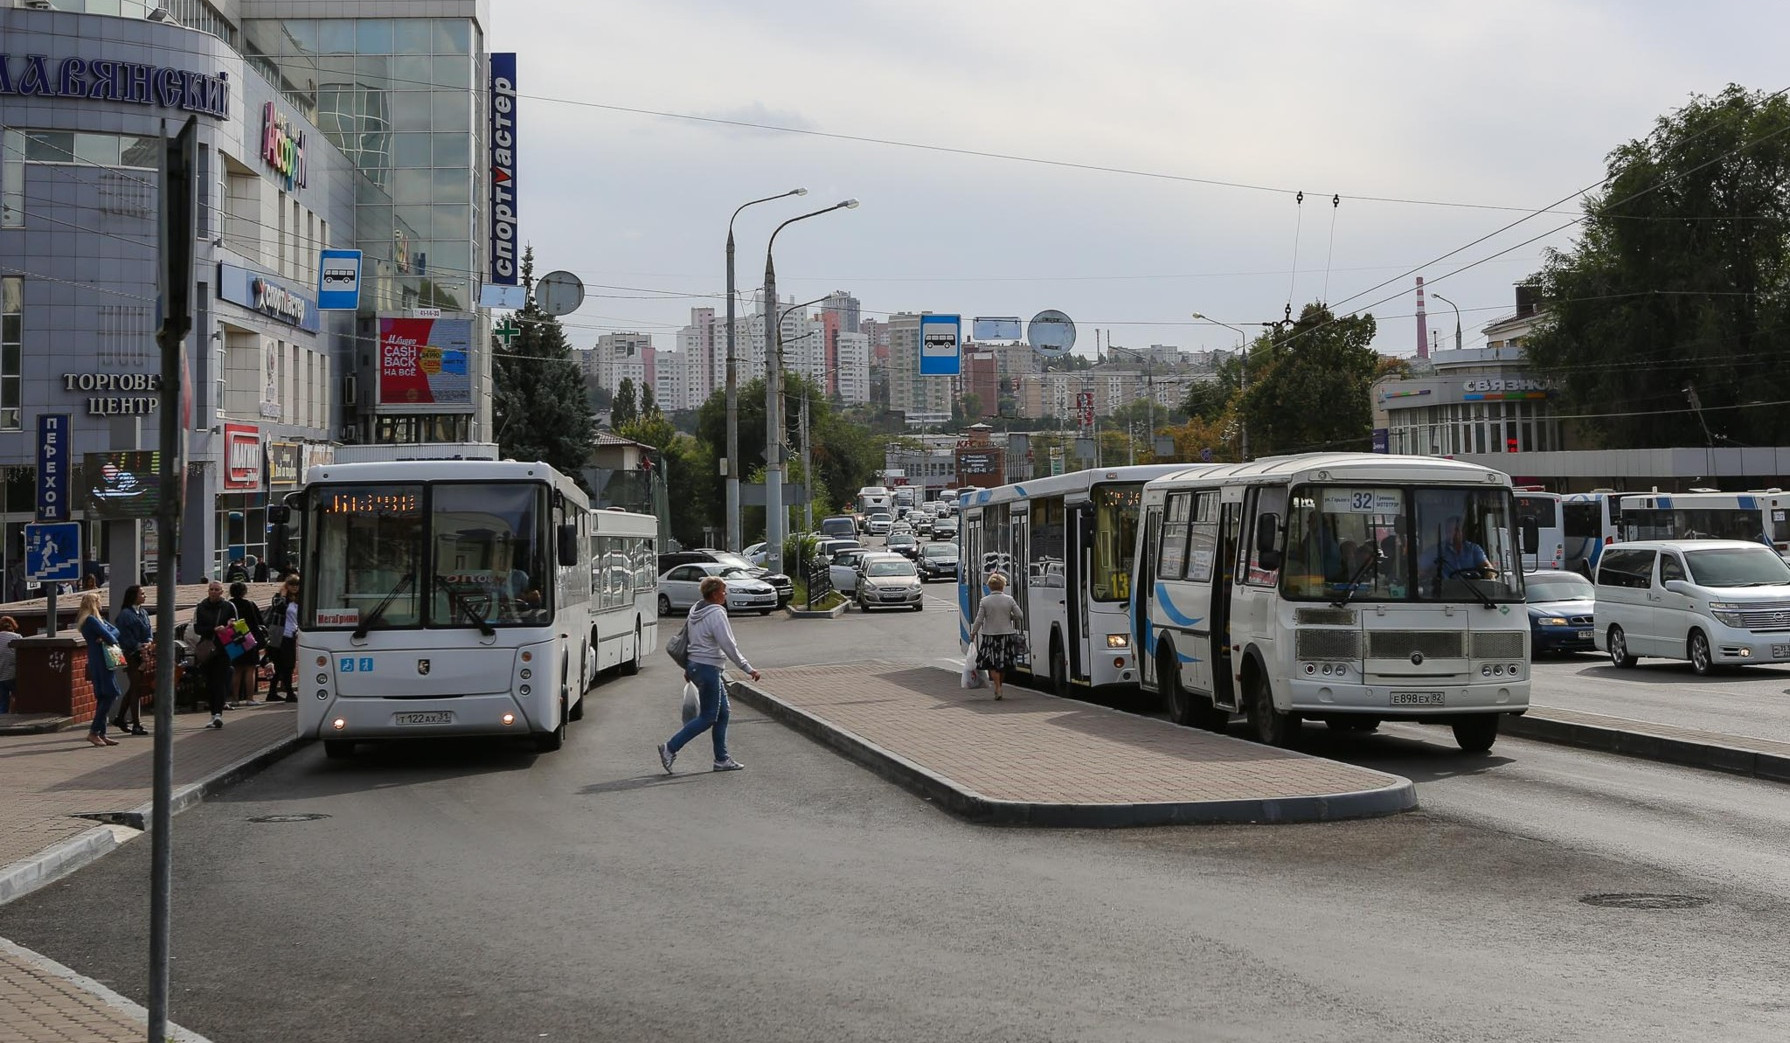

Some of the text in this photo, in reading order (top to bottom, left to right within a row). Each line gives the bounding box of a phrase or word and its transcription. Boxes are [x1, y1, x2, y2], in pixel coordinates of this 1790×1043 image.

[384, 346, 417, 357] CASH
[384, 357, 417, 367] BACK
[399, 367, 417, 376] ВСЁ
[64, 373, 163, 391] ТОРГОВ
[1463, 379, 1552, 392] СВЯЗНО
[89, 397, 159, 417] ЦЕНТР
[44, 417, 58, 518] ПЕРЕХОД
[1353, 492, 1373, 509] 32
[1111, 573, 1129, 599] 13
